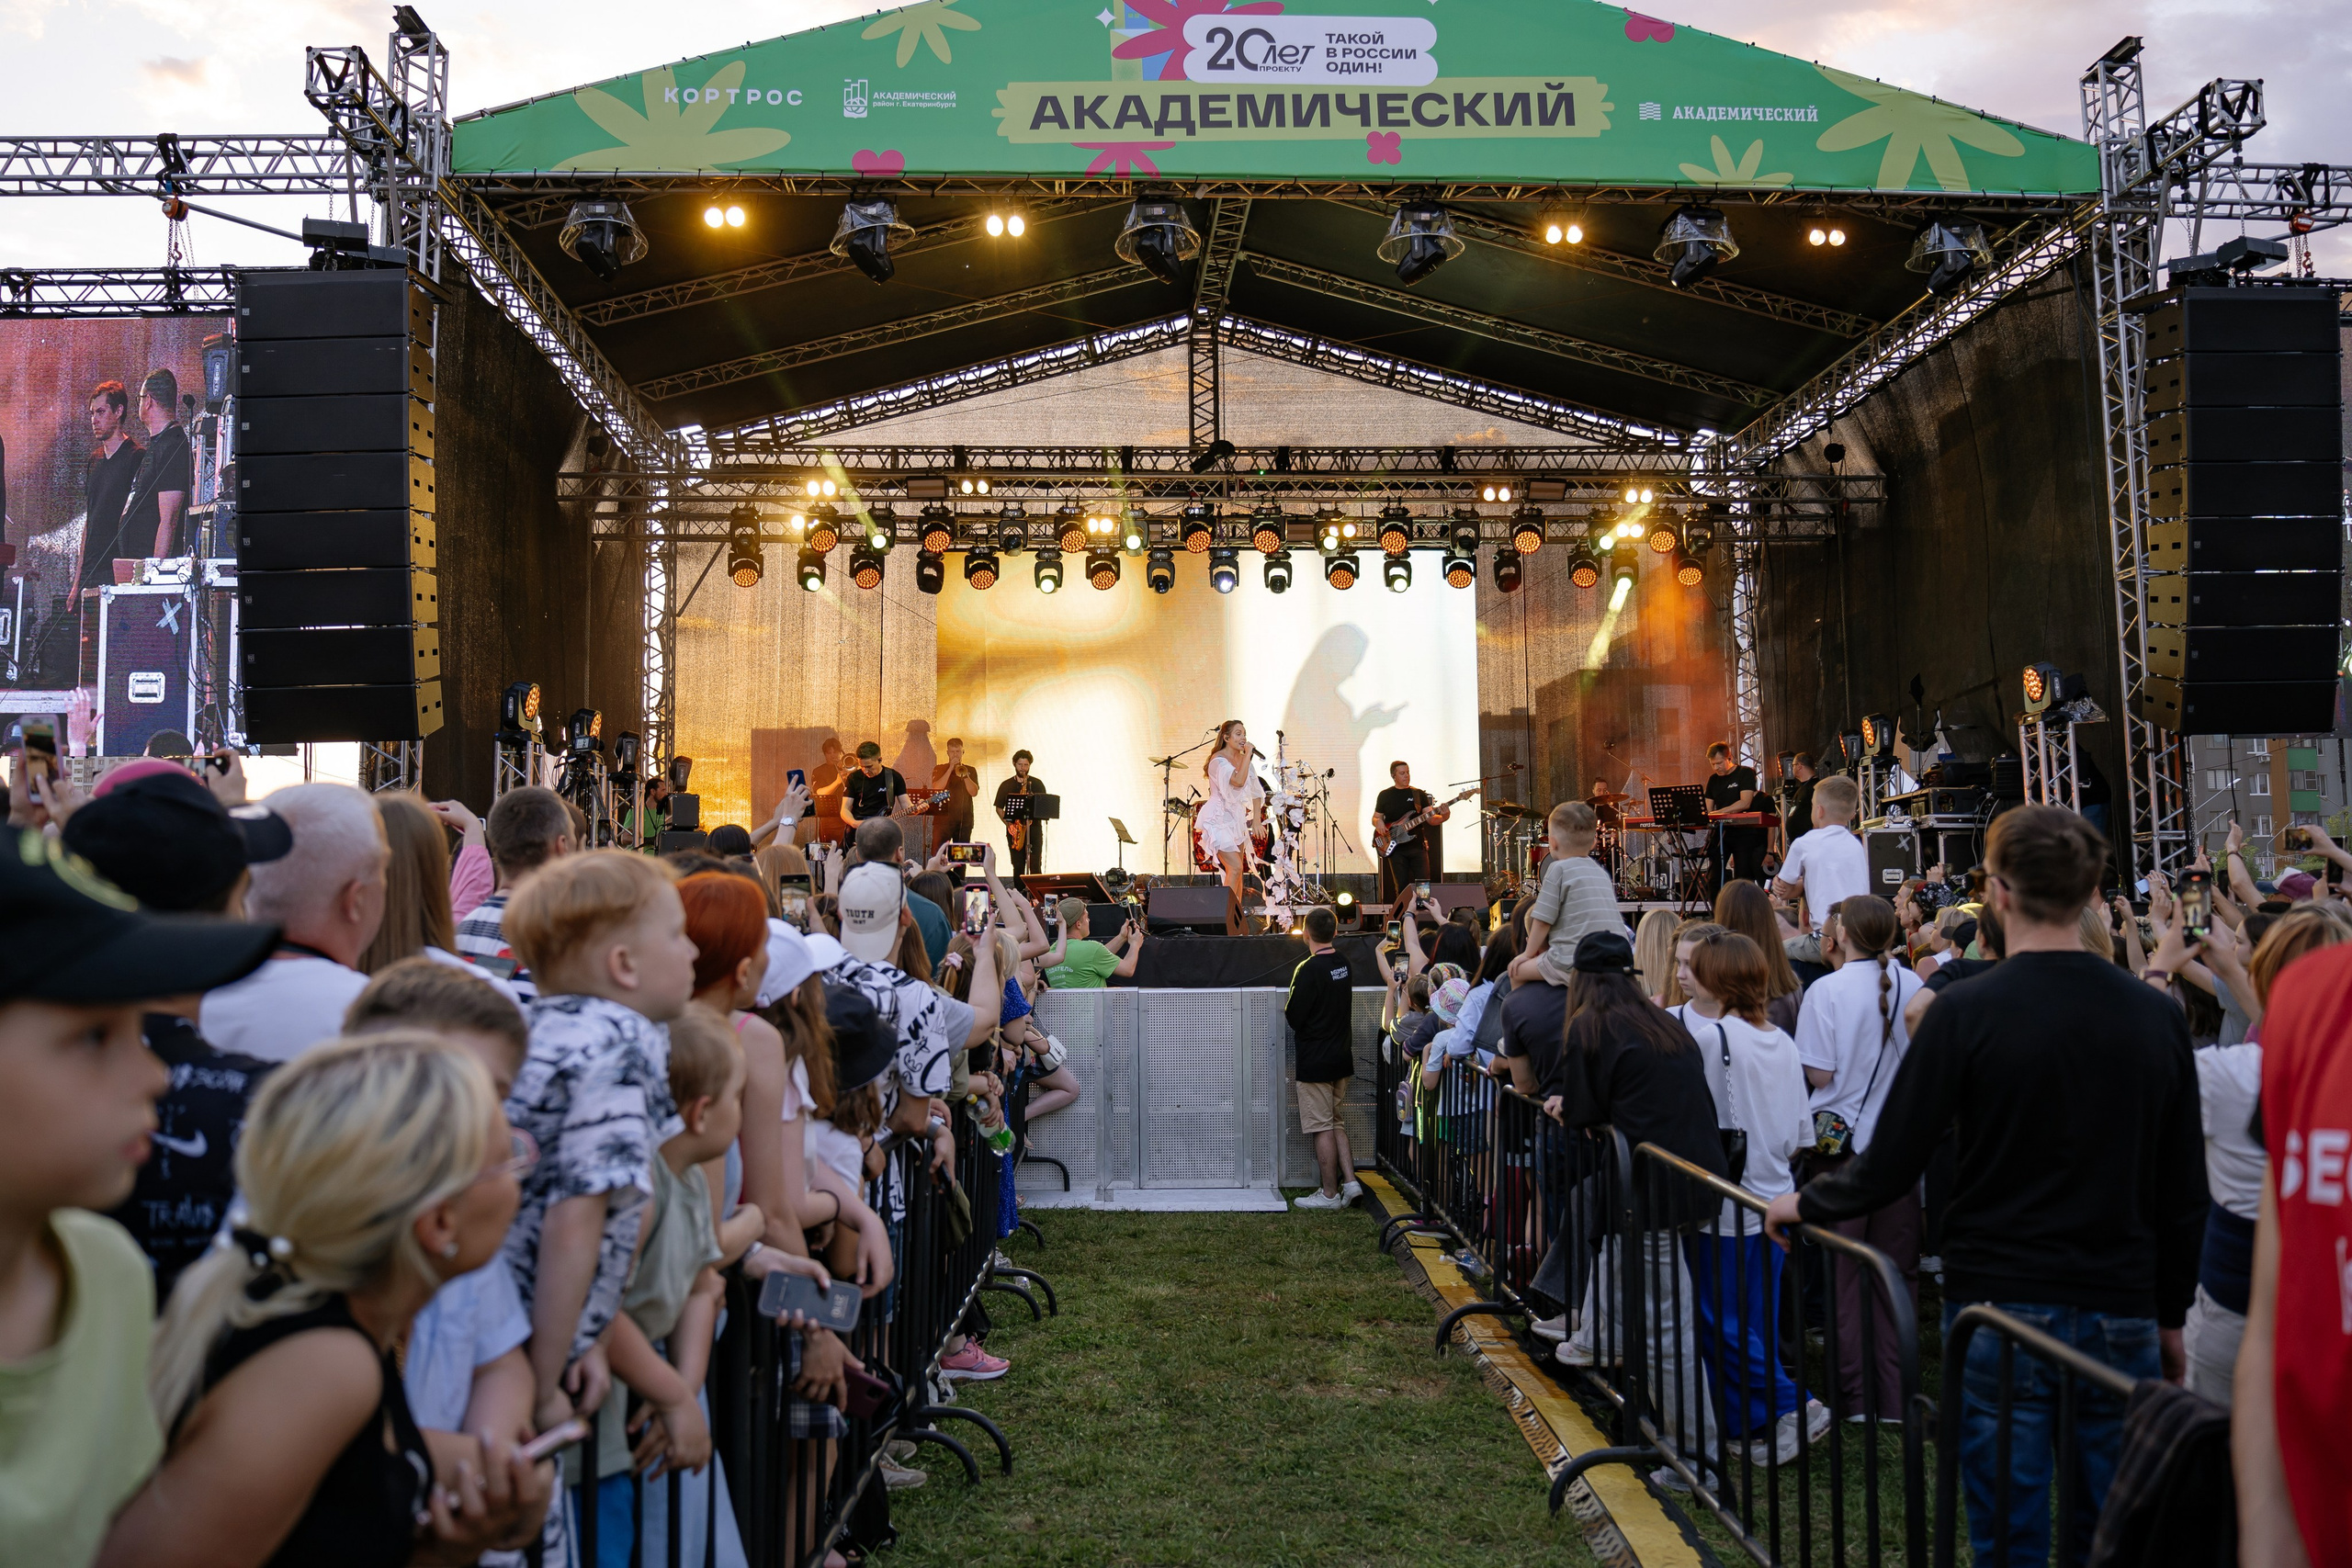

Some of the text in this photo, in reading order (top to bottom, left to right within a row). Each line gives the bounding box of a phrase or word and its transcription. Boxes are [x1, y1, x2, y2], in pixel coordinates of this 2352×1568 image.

[1325, 30, 1385, 45] ТАКОЙ
[1205, 27, 1276, 72] 20
[1326, 47, 1417, 60] В РОССИИ
[1326, 62, 1383, 74] ОДИН!
[664, 87, 803, 106] КОРТРОС
[873, 91, 956, 101] АКАДЕМИЧЕСКИЙ
[1029, 82, 1577, 137] АКАДЕМИЧЕСКИЙ
[1672, 105, 1819, 122] АКАДЕМИЧЕСКИЙ
[2279, 1127, 2352, 1207] SE
